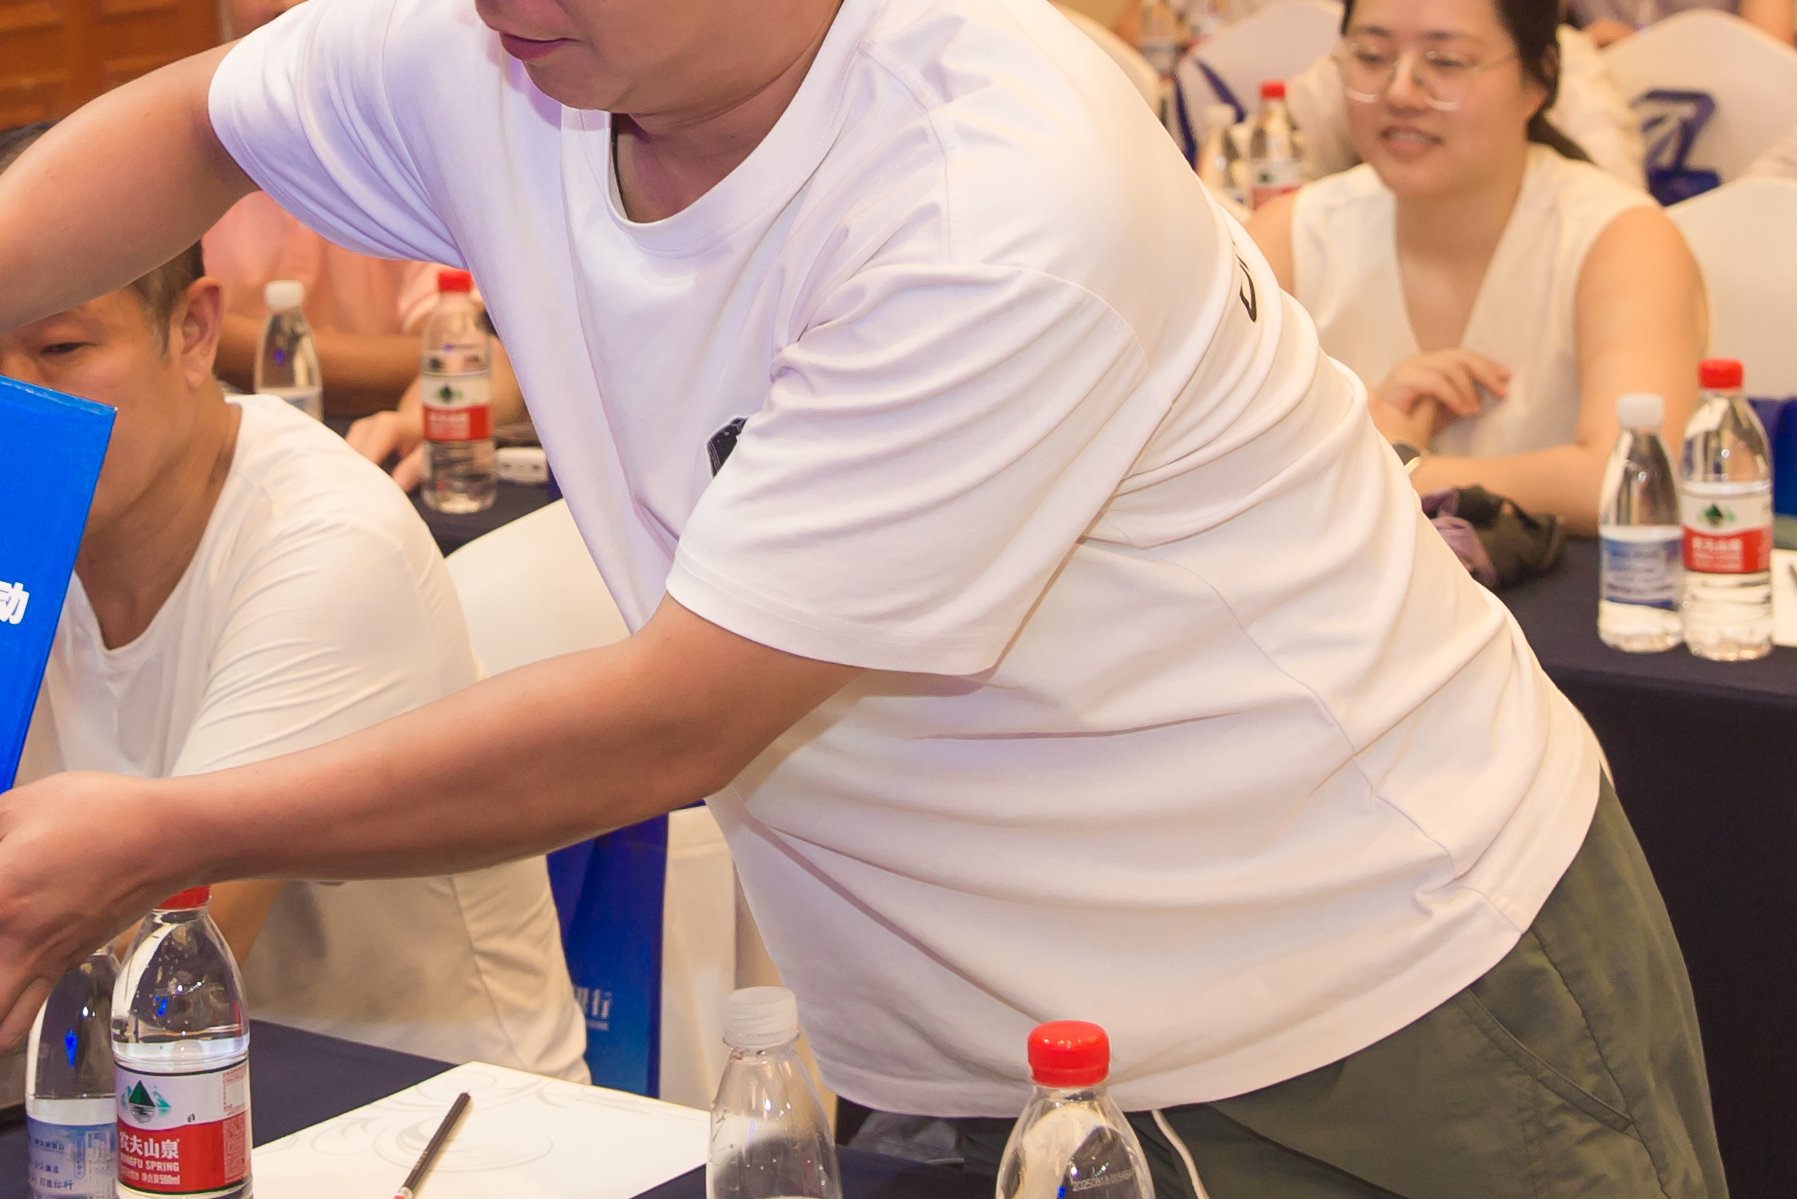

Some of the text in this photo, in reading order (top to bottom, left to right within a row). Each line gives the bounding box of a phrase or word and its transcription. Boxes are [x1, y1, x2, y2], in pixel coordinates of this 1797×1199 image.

[119, 1131, 180, 1160] 农夫山泉
[145, 1160, 180, 1172] SPRING
